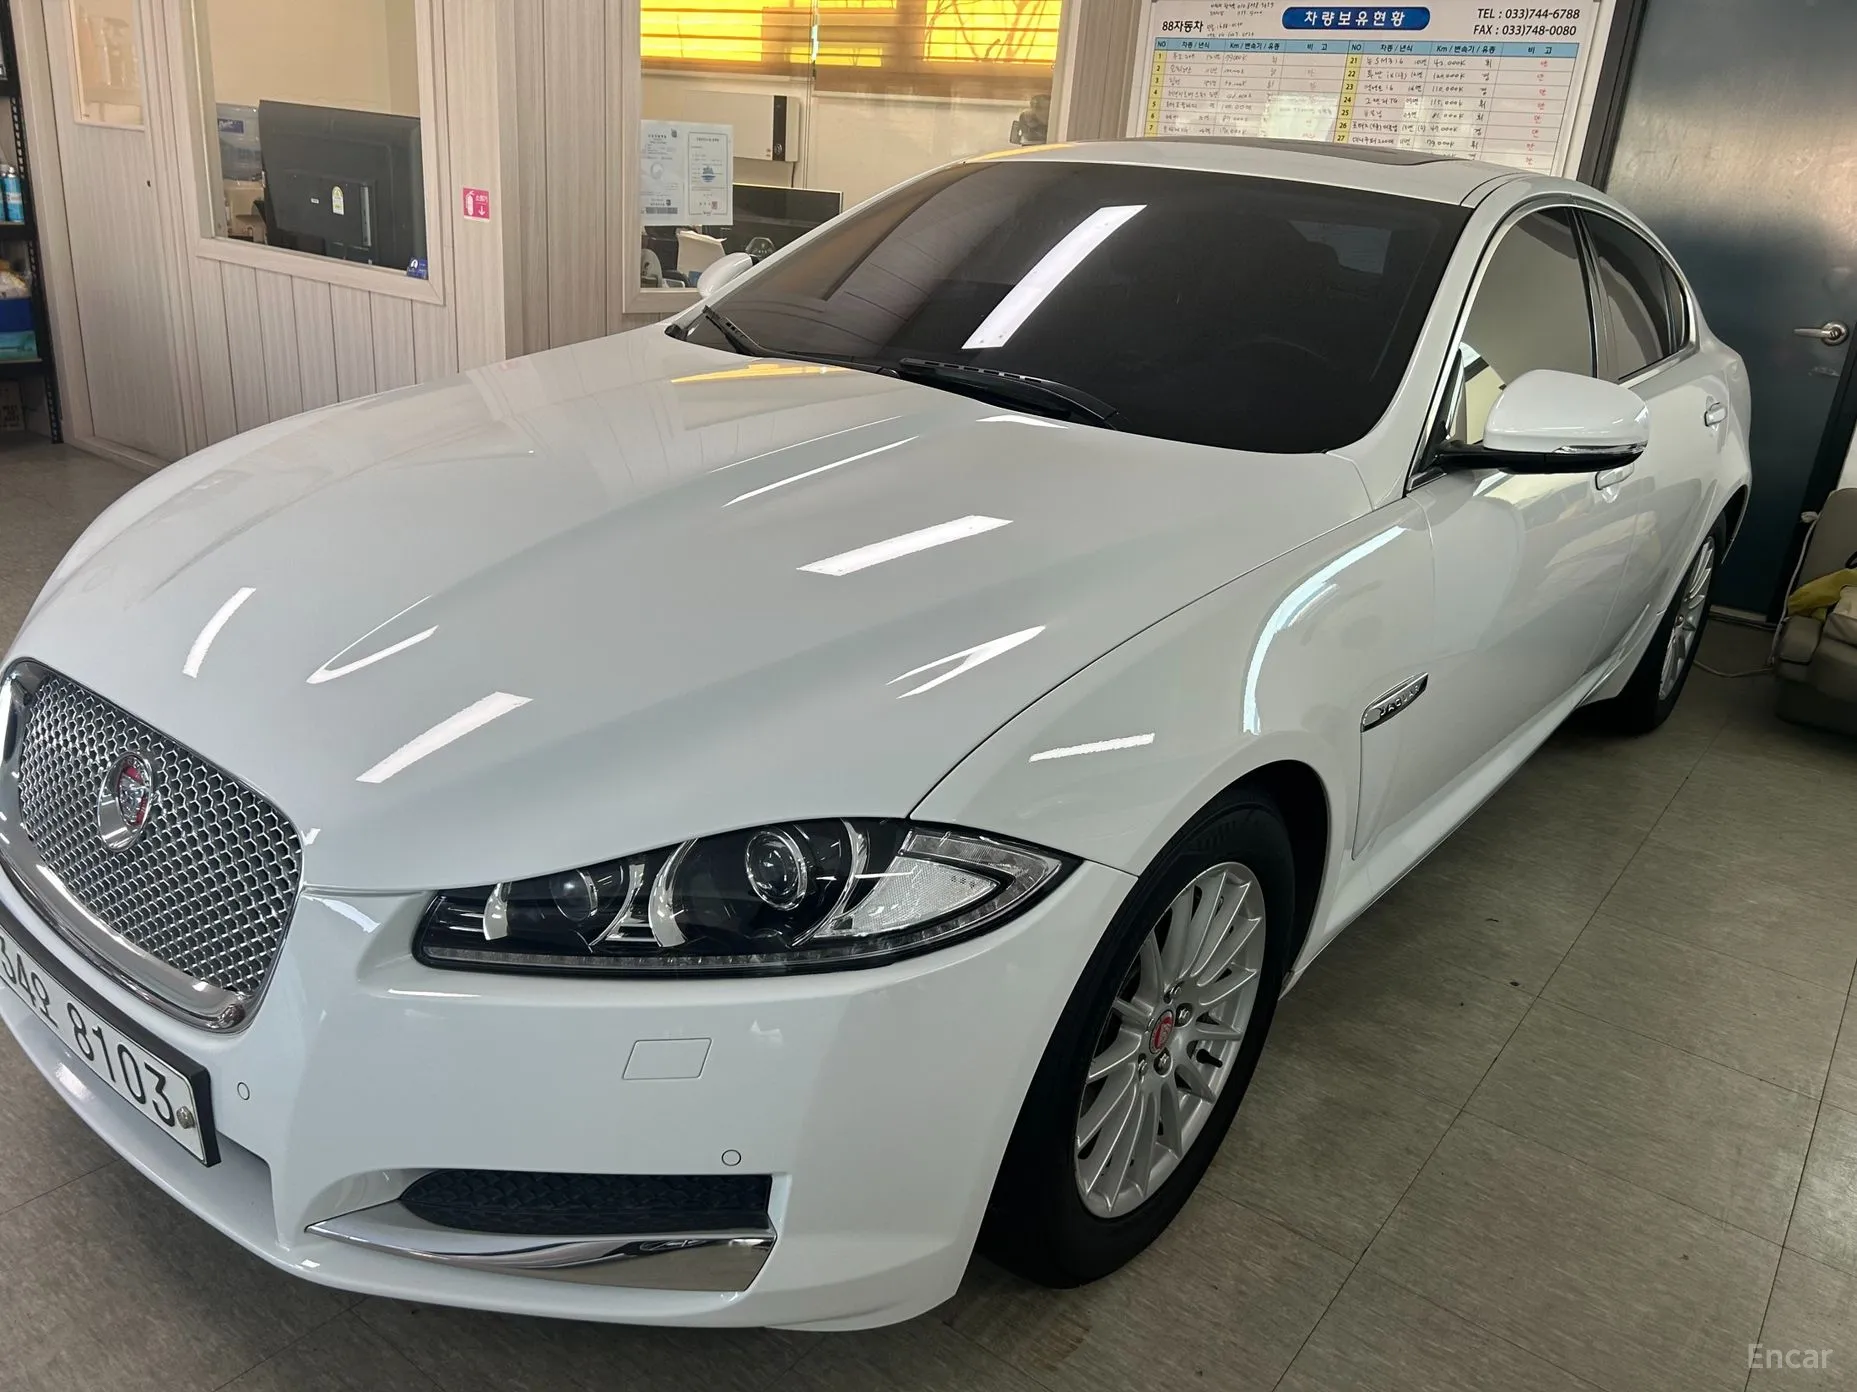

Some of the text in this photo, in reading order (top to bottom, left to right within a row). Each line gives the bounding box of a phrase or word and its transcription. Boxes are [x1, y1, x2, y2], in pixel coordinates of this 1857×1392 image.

[1304, 10, 1406, 27] 차량보유현황
[1477, 8, 1495, 19] TEL
[1505, 8, 1580, 20] 033)744-6788
[1162, 20, 1203, 33] 88자동차
[1473, 24, 1492, 35] FAX
[1502, 25, 1577, 36] 033)748-0080
[1436, 45, 1448, 53] Km
[1350, 57, 1358, 65] 21
[1348, 70, 1356, 78] 22
[1345, 83, 1354, 91] 23
[1343, 96, 1352, 104] 24
[0, 935, 176, 1128] 34오 8103
